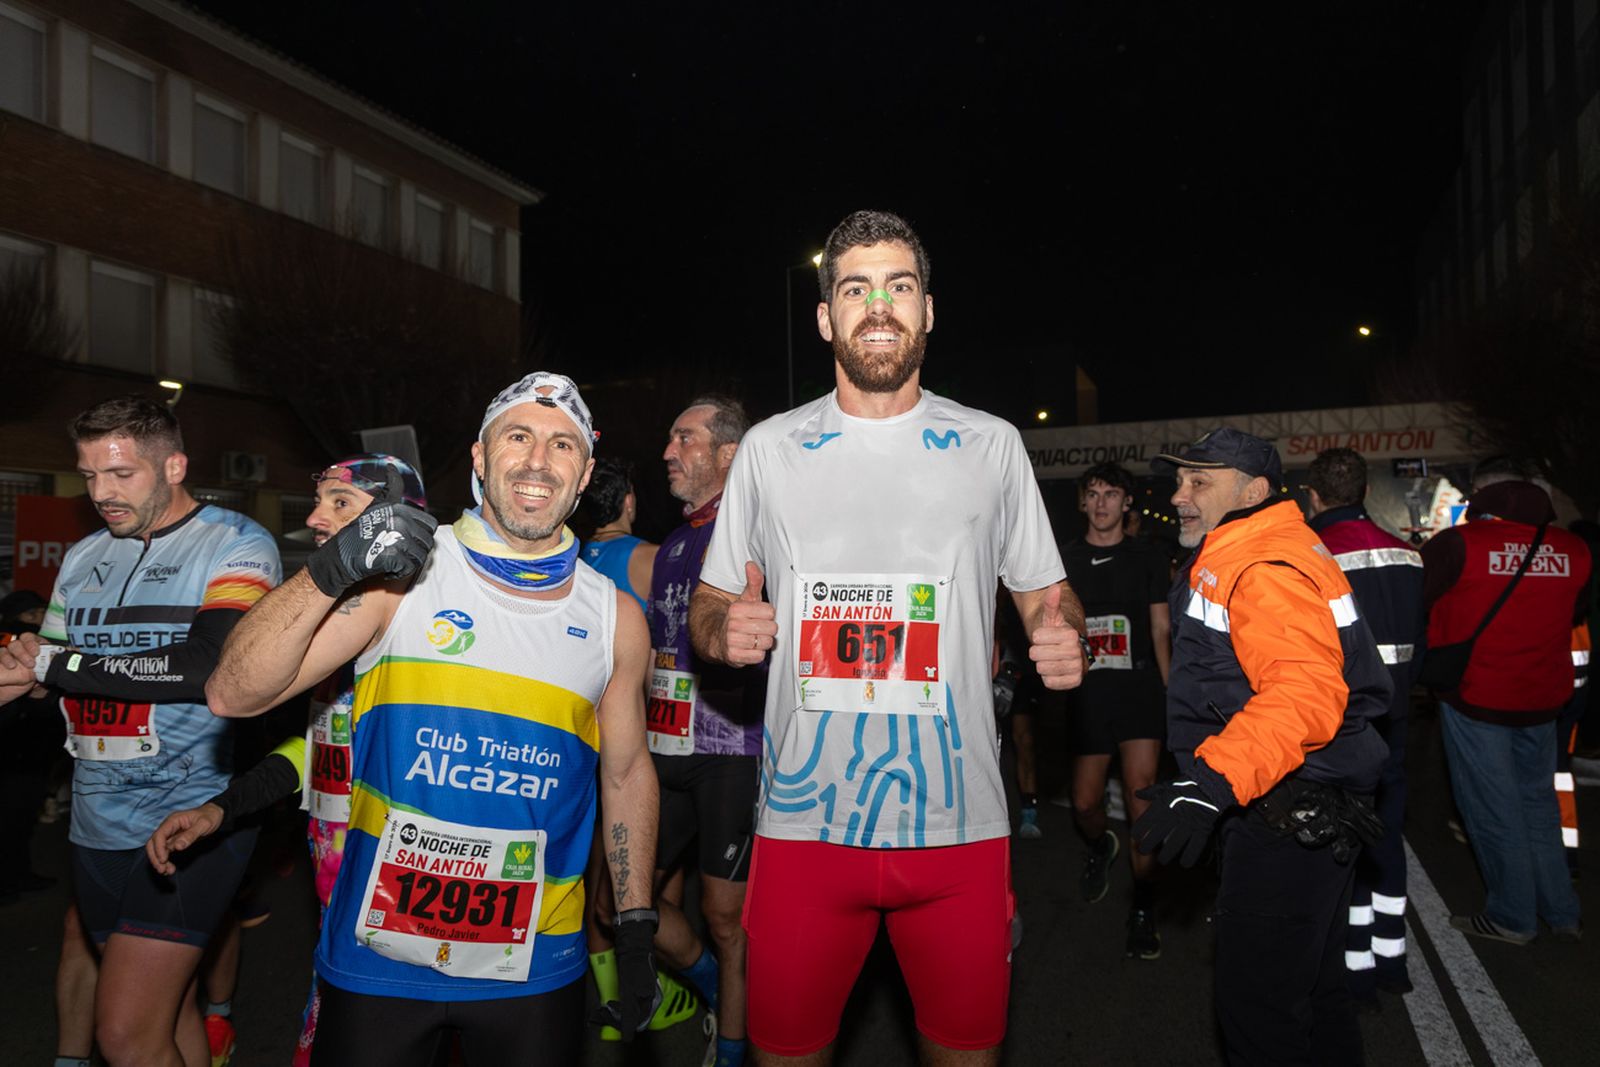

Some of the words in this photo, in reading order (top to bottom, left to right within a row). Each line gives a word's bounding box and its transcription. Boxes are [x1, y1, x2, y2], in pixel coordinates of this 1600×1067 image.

[1288, 433, 1339, 455] SAN
[1350, 426, 1435, 452] ANTÓN
[19, 541, 73, 568] PR
[369, 541, 382, 556] 43
[1504, 542, 1554, 554] DIAIO
[812, 585, 827, 597] 43
[830, 589, 873, 602] NOCHE
[877, 590, 893, 602] DE
[812, 605, 841, 620] SAN
[843, 603, 893, 620] ANTÓN
[837, 622, 905, 664] 651
[103, 655, 169, 679] MARATHON
[416, 727, 468, 753] Club
[478, 736, 561, 768] Triatlón
[404, 750, 559, 800] Alcázar
[400, 828, 417, 841] 43
[417, 836, 471, 857] NOCHE
[471, 844, 492, 858] DE
[395, 849, 430, 870] SAN
[428, 857, 488, 878] ANTÓN
[396, 871, 520, 928] 12931
[416, 922, 445, 937] Pedro
[448, 928, 480, 940] Javier
